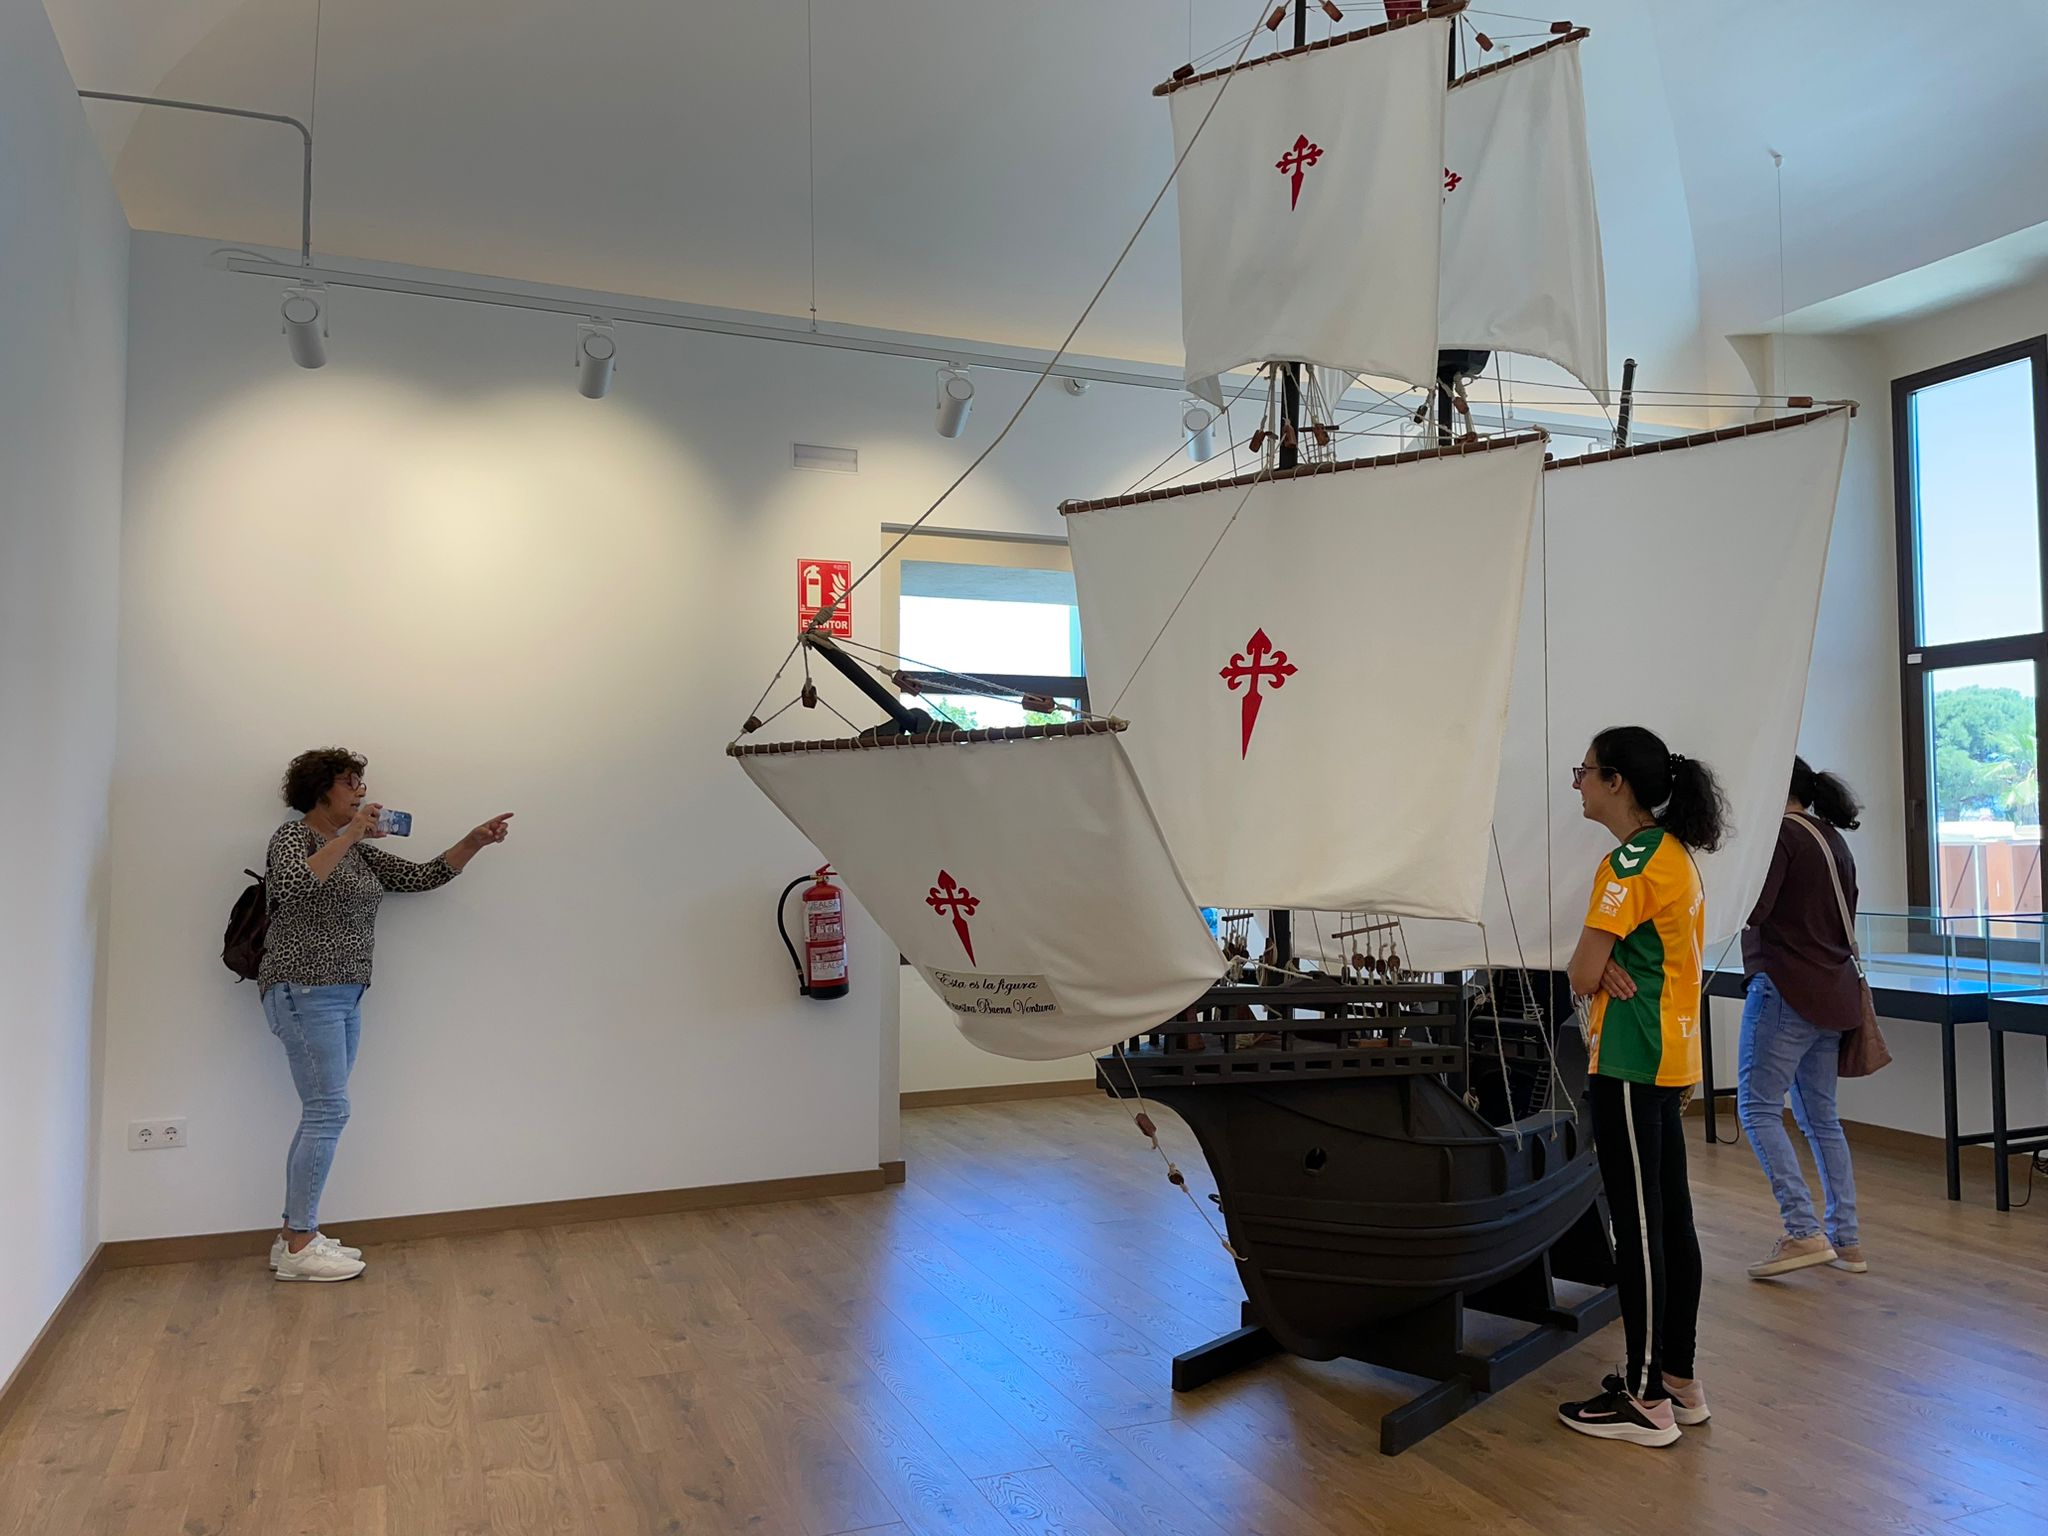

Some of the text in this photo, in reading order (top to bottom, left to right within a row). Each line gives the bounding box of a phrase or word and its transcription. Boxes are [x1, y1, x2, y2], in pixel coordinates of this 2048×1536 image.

[802, 619, 848, 630] EXNTOR
[935, 971, 1038, 996] Esta es la figura
[976, 997, 1012, 1014] Buena
[1012, 996, 1056, 1014] Ventura
